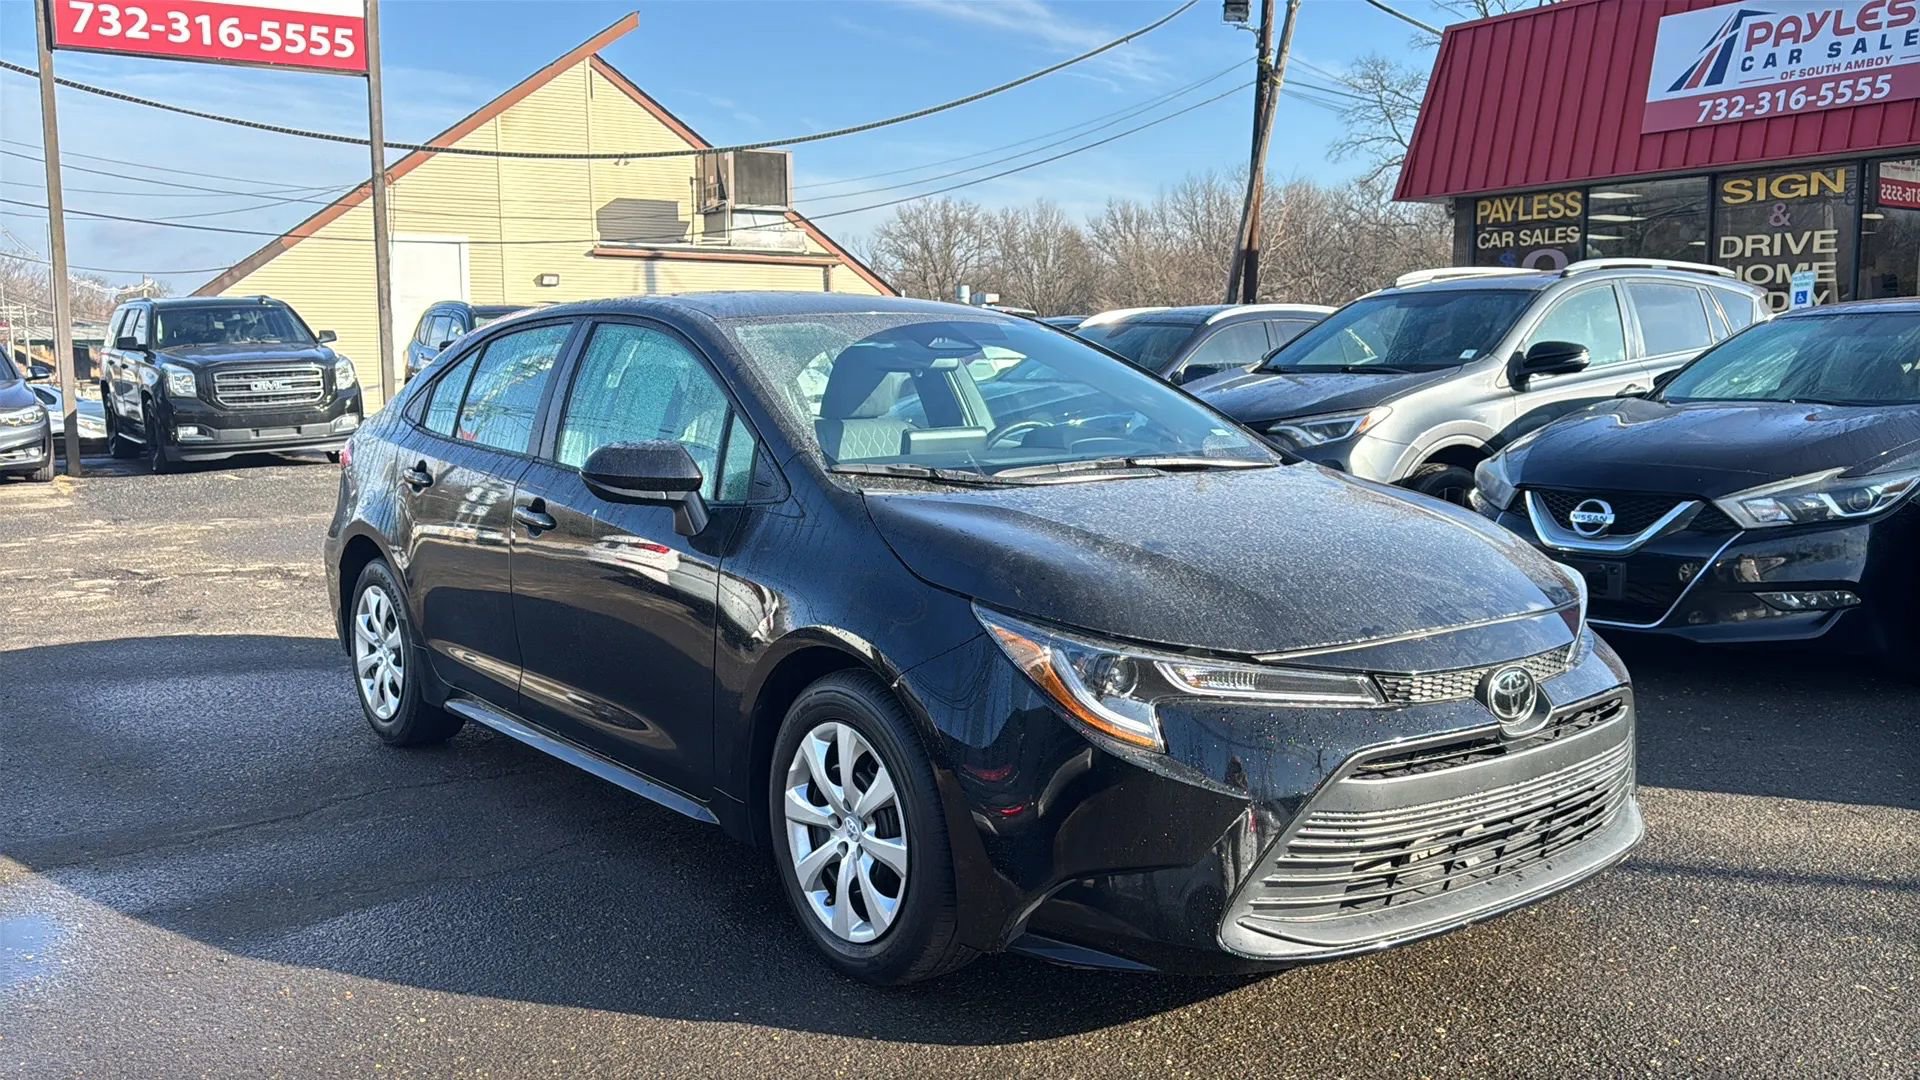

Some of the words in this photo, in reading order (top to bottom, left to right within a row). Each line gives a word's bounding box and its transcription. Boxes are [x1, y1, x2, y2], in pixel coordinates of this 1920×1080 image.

[68, 0, 356, 58] 732-316-5555
[1744, 0, 1920, 53] PAYLES
[1741, 48, 1803, 72] CAR
[1780, 69, 1797, 81] OF
[1799, 62, 1842, 78] SOUTH
[1844, 54, 1894, 71] AMBOY
[1696, 74, 1892, 123] 732-316-5555
[1722, 167, 1846, 205] SIGN
[1476, 191, 1583, 225] PAYLESS
[1769, 202, 1792, 227] &
[1477, 231, 1514, 249] CAR
[1518, 226, 1581, 247] SALES
[1719, 229, 1839, 259] DRIVE
[1572, 512, 1608, 522] NISSAN
